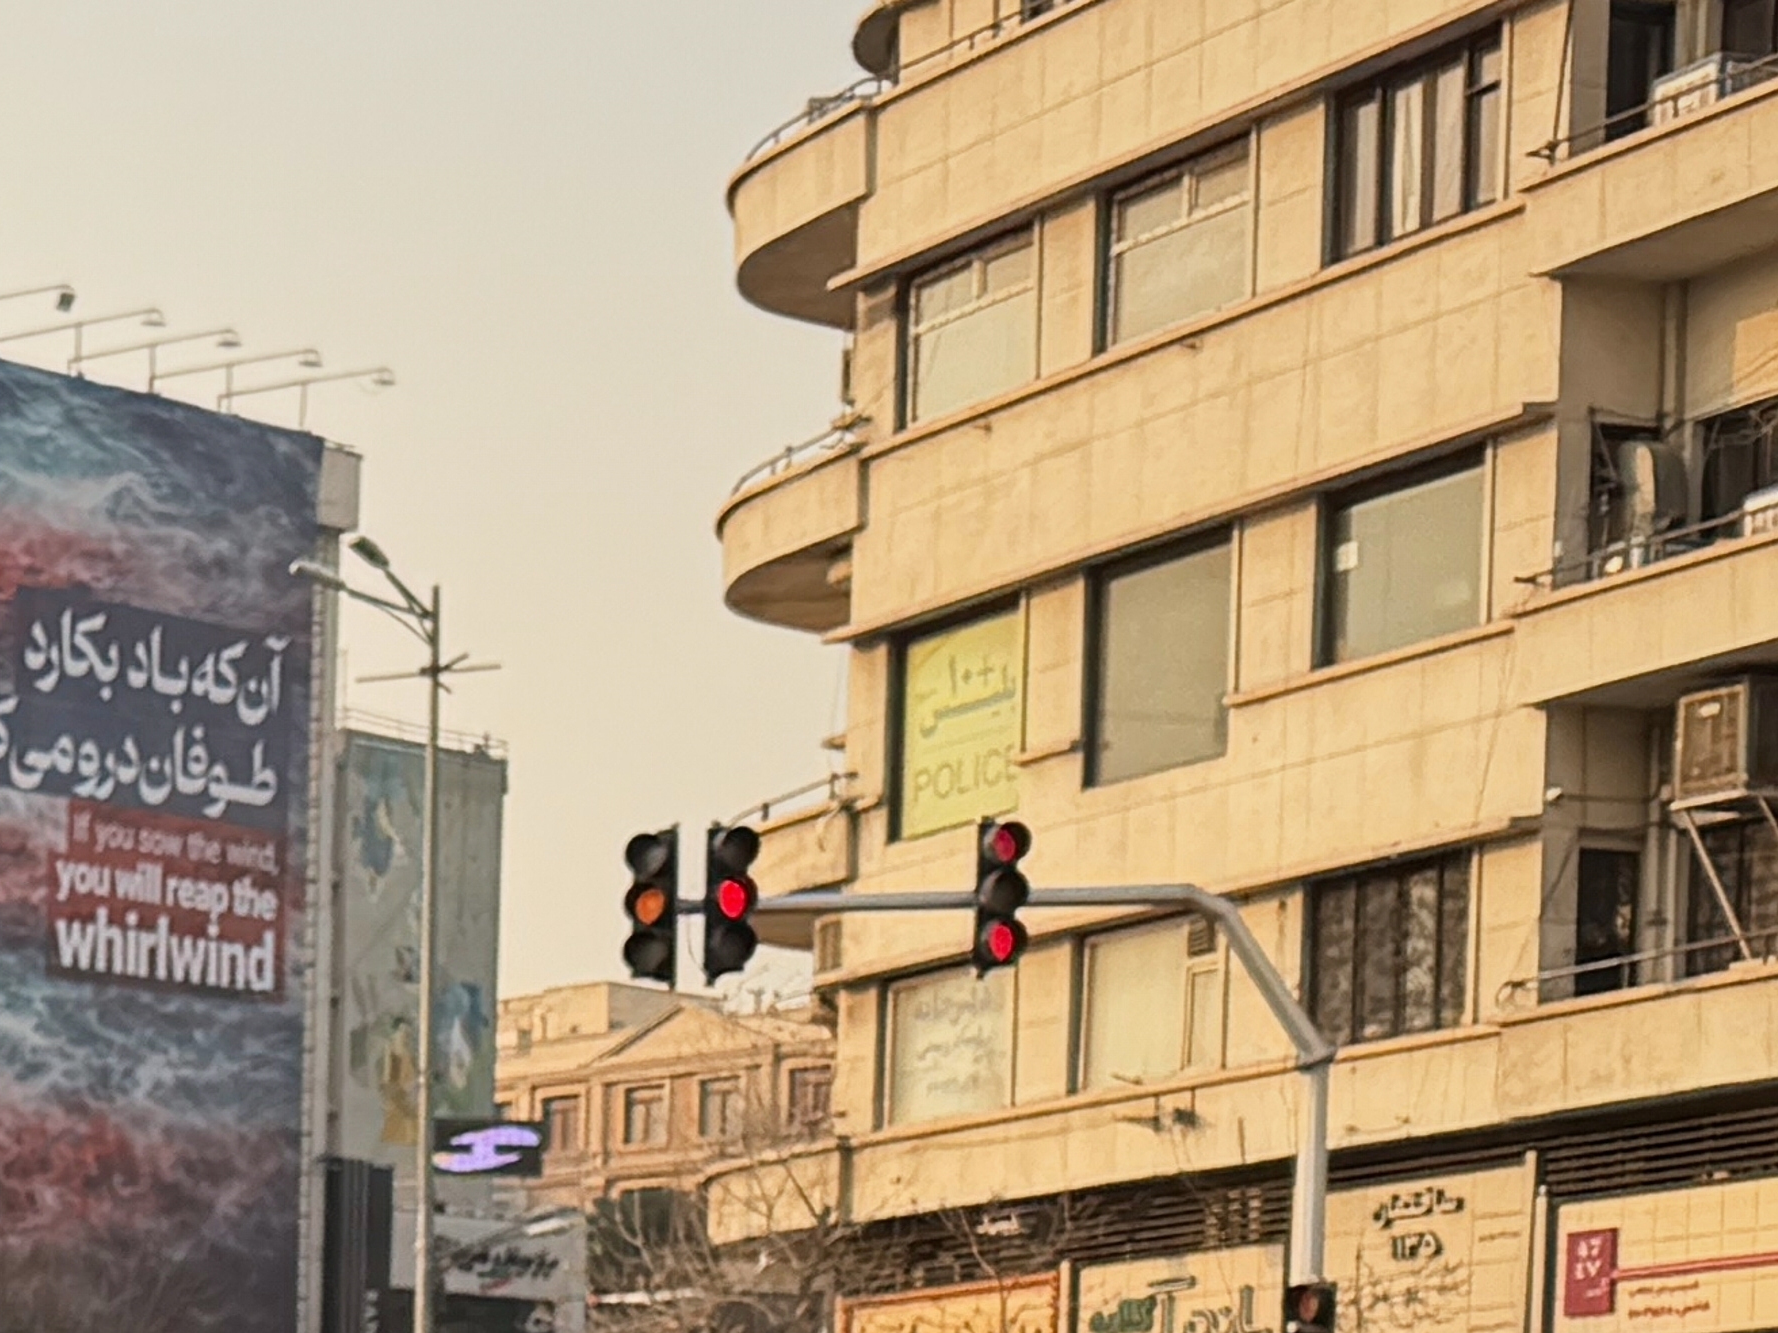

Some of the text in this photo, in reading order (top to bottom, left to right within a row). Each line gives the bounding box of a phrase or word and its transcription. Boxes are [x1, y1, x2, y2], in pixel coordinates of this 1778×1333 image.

[24, 607, 119, 702] بکارد
[126, 625, 188, 714] باد
[139, 722, 278, 819] طوفان
[912, 743, 1018, 803] POLICE
[95, 820, 136, 853] you
[138, 826, 184, 858] sow
[186, 830, 222, 865] the
[55, 859, 279, 923] you will reap the
[54, 904, 275, 992] whirlwind
